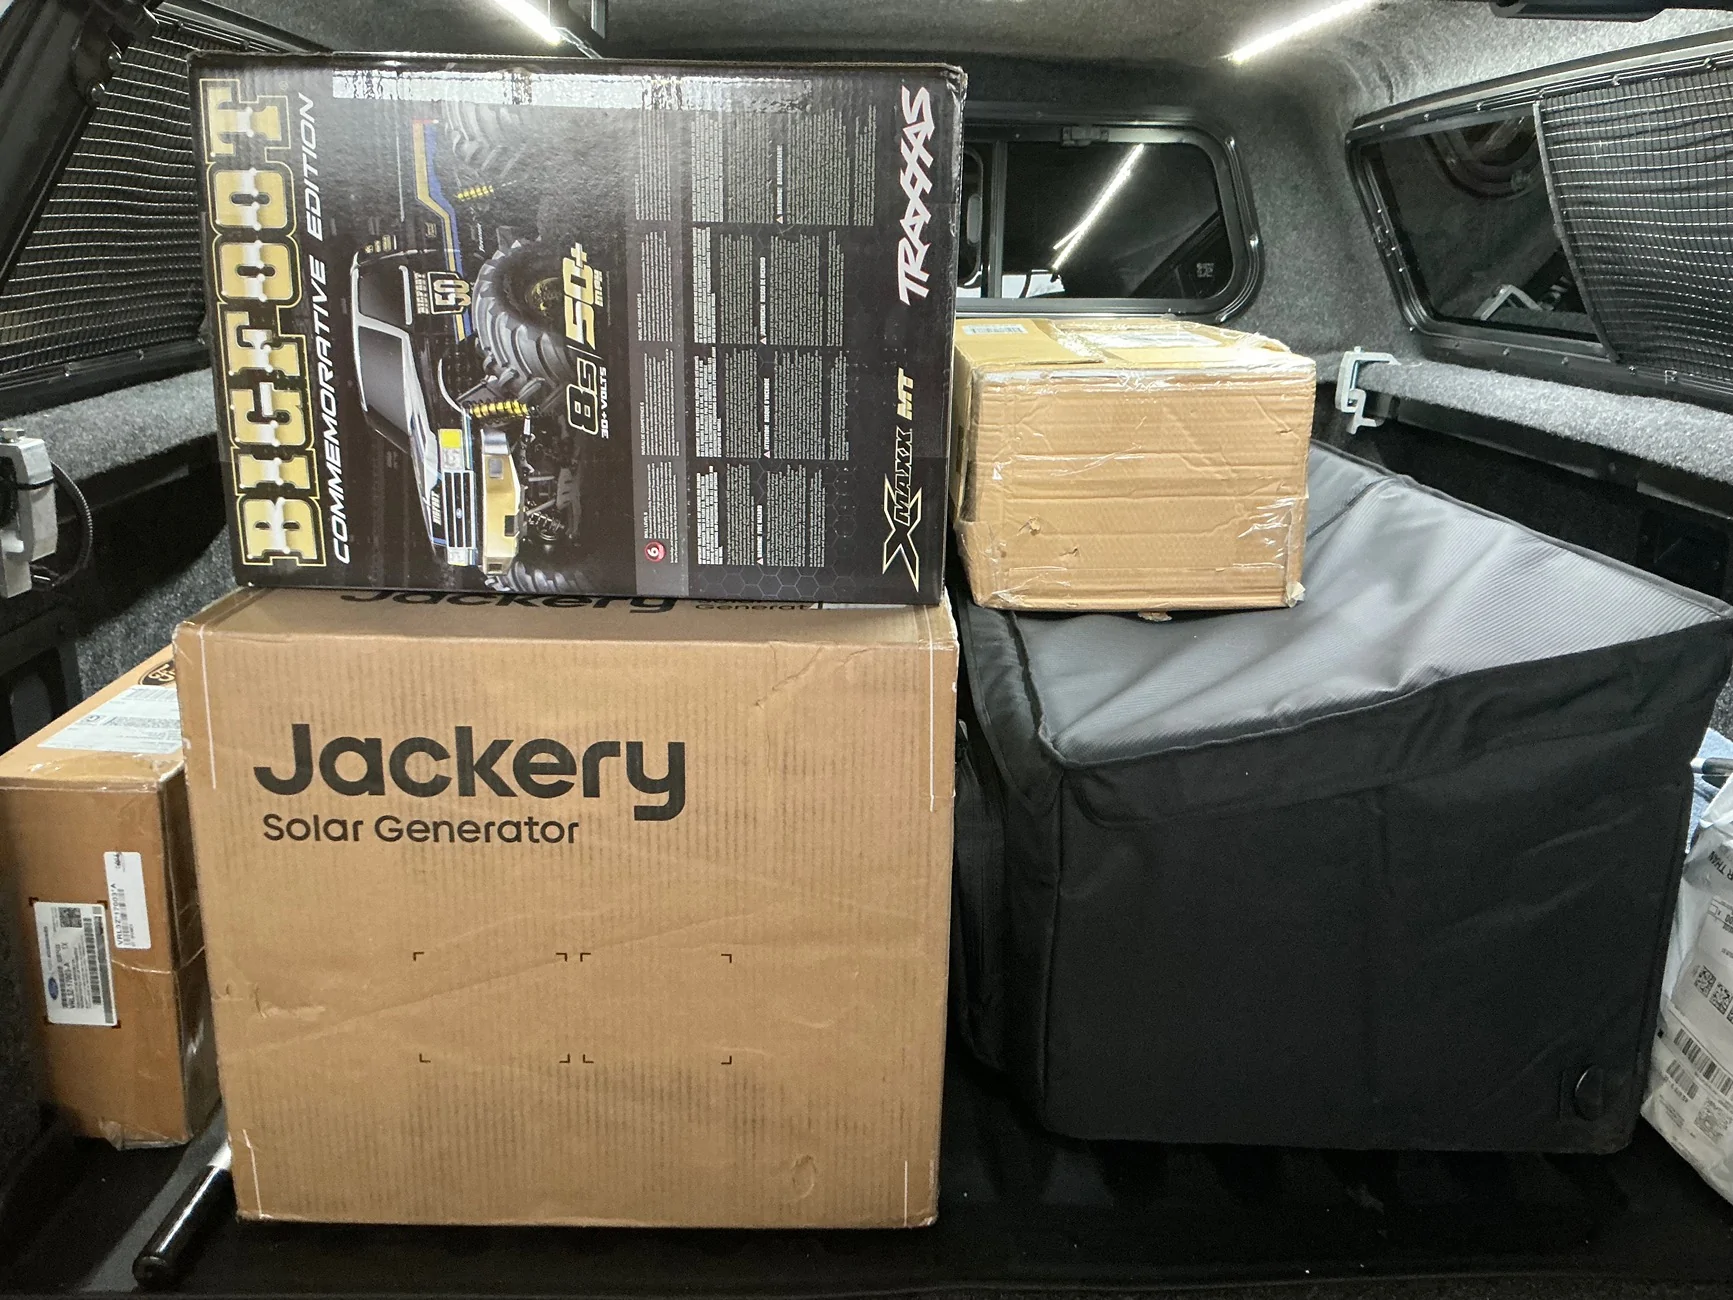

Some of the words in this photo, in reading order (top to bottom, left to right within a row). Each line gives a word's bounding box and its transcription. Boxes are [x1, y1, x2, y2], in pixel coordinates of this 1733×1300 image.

[298, 92, 323, 242] EDITION
[898, 85, 936, 306] TRAXXAS
[414, 271, 429, 314] BIGFOOT
[433, 280, 472, 306] 50
[562, 242, 596, 350] 50+
[205, 85, 320, 562] BIGFOOT
[309, 255, 350, 564] COMMEMORATIVE
[599, 367, 608, 410] VOLTS
[897, 367, 914, 421] MT
[600, 412, 609, 439] 30+
[648, 547, 659, 557] 6
[254, 723, 685, 821] Jackery
[263, 813, 363, 842] Solar
[375, 814, 579, 844] Generator
